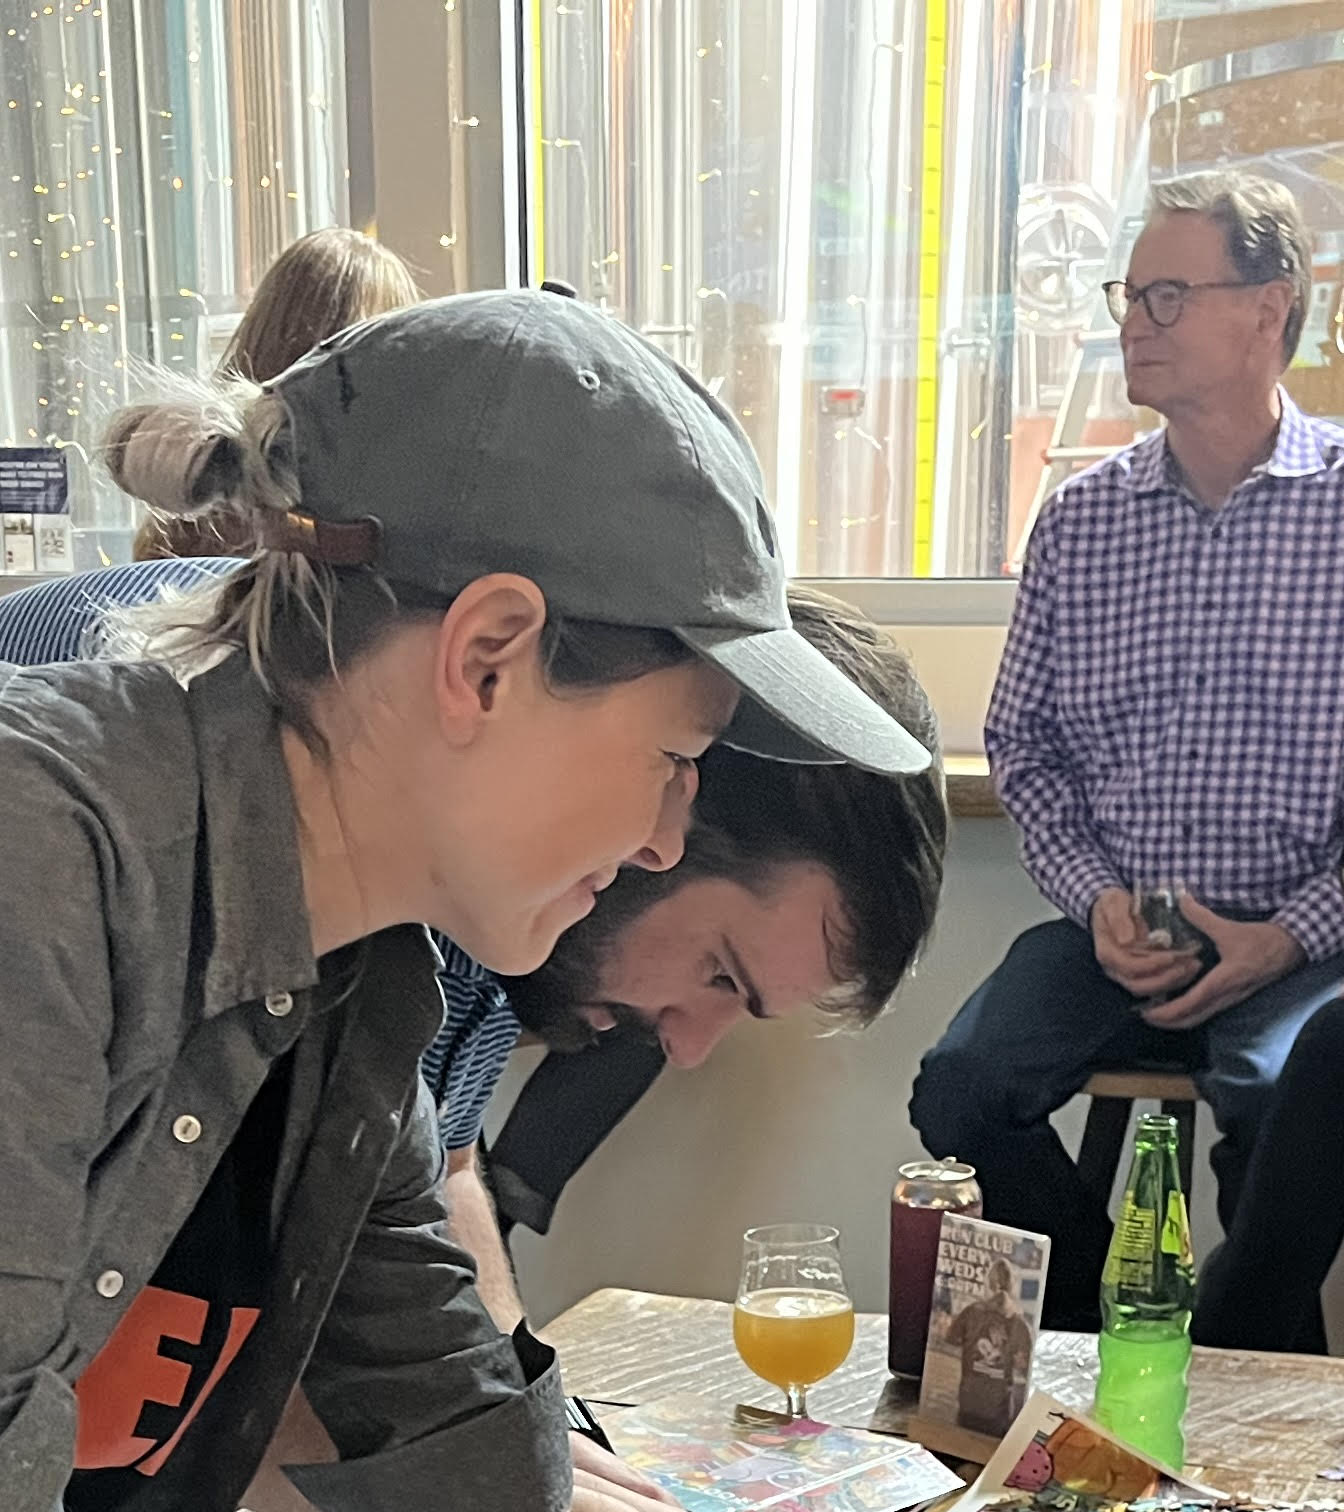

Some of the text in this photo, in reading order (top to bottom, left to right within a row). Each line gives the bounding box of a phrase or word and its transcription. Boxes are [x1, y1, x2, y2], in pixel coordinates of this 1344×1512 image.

[939, 1242, 990, 1264] EVERY
[974, 1231, 1013, 1254] CLUB
[937, 1257, 983, 1281] WEDS
